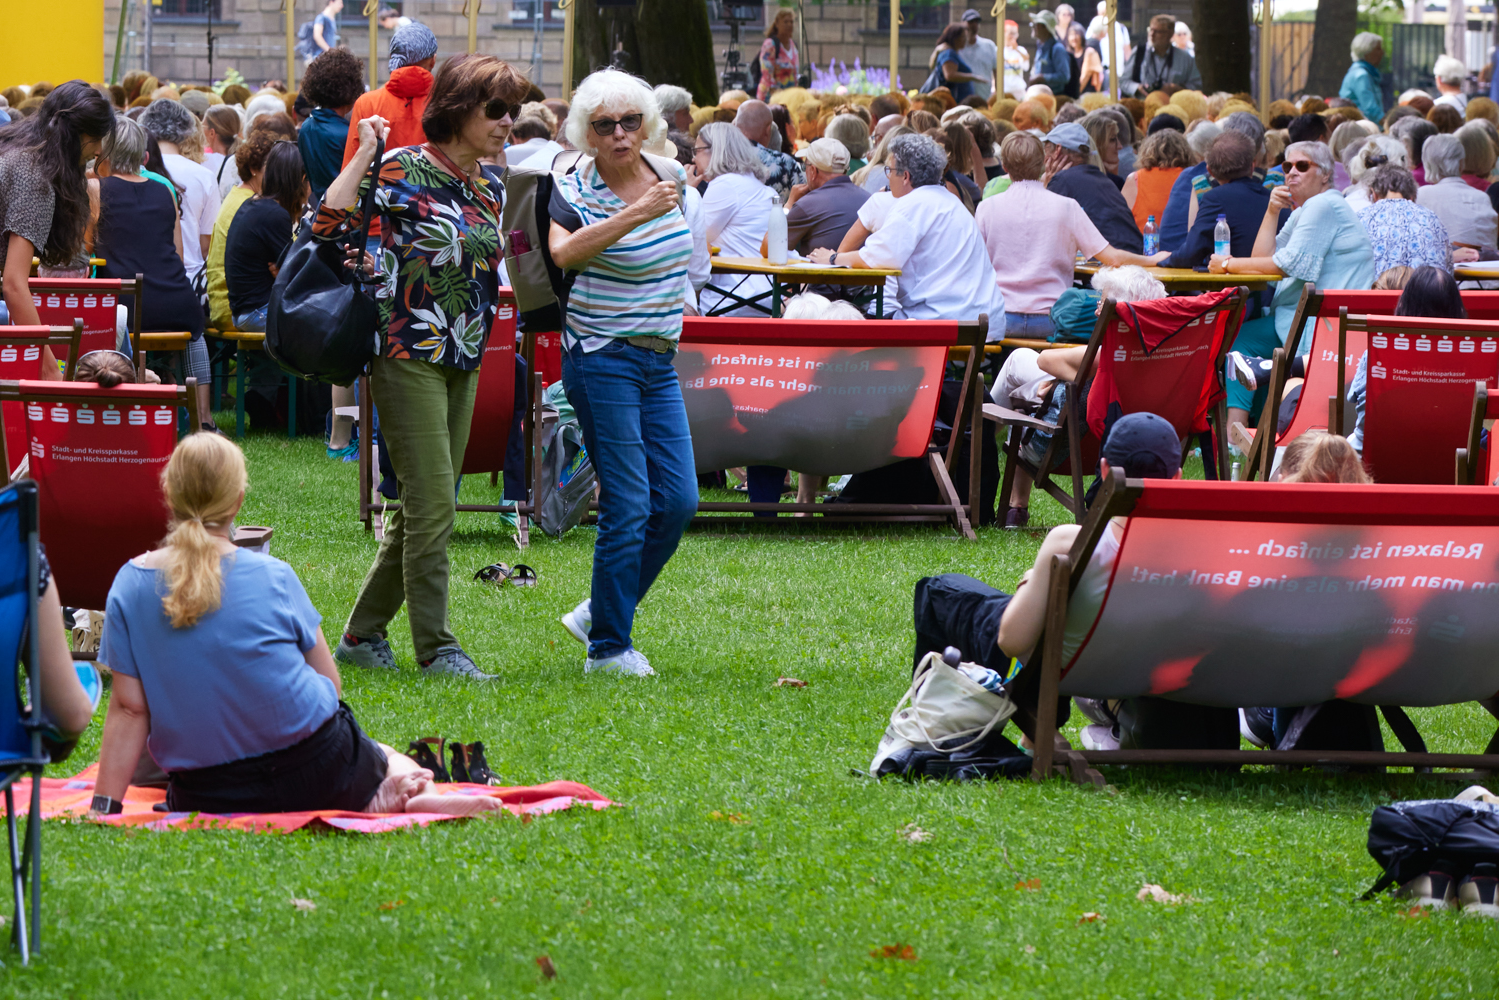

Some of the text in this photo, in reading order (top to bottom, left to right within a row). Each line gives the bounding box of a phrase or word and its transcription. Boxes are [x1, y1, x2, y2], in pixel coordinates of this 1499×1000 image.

[1423, 370, 1465, 378] Kreissparkasse
[1392, 375, 1418, 383] Erlangen
[1418, 376, 1448, 384] Höchstadt
[51, 445, 72, 453] Stadt-
[88, 447, 138, 456] Kreissparkasse
[52, 453, 82, 463] Erlangen
[83, 455, 118, 463] Höchstadt
